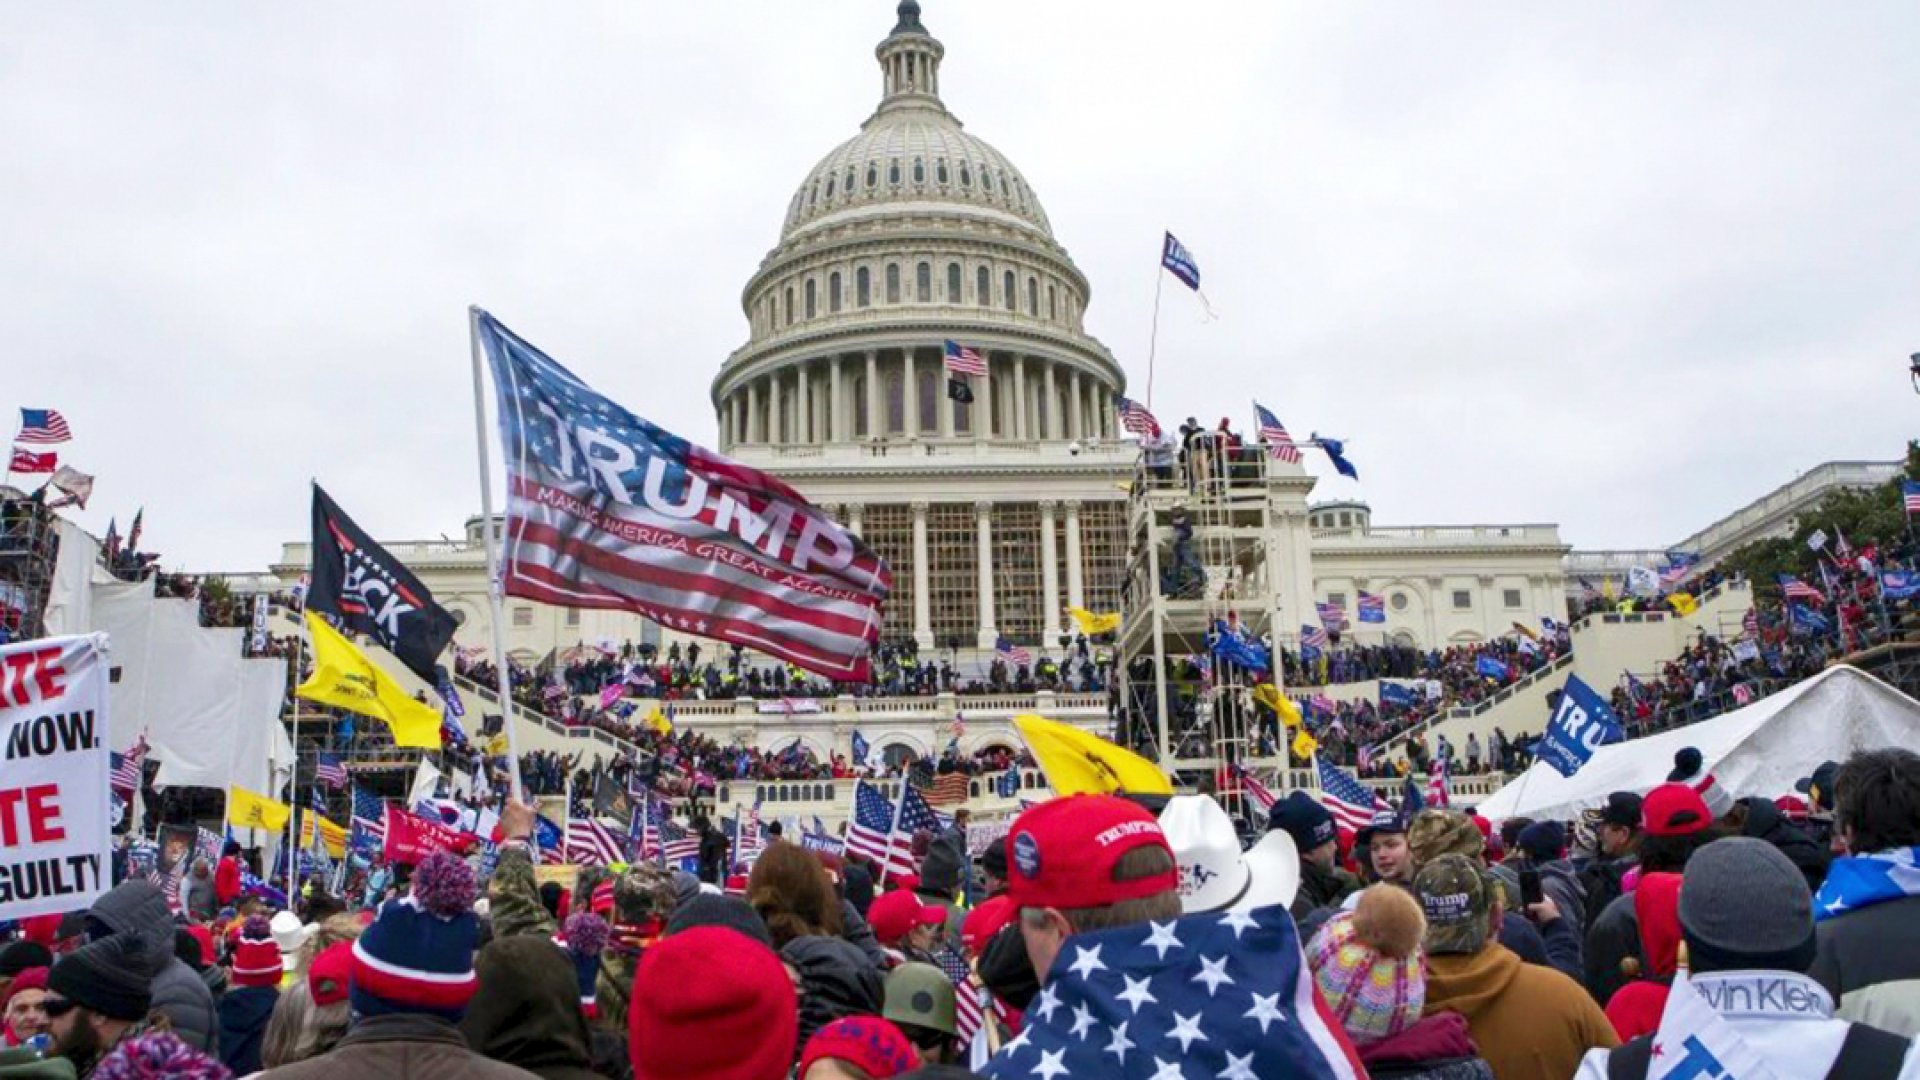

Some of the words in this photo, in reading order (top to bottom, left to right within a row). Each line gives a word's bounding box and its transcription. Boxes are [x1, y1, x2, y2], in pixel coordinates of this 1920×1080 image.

[538, 401, 855, 571] TRUMP
[537, 487, 600, 525] MAKING
[602, 517, 689, 551] AMERICA
[696, 543, 776, 578] GREAT
[780, 575, 858, 600] AGAIN!
[6, 709, 100, 760] NOW.
[1697, 979, 1753, 1012] vin
